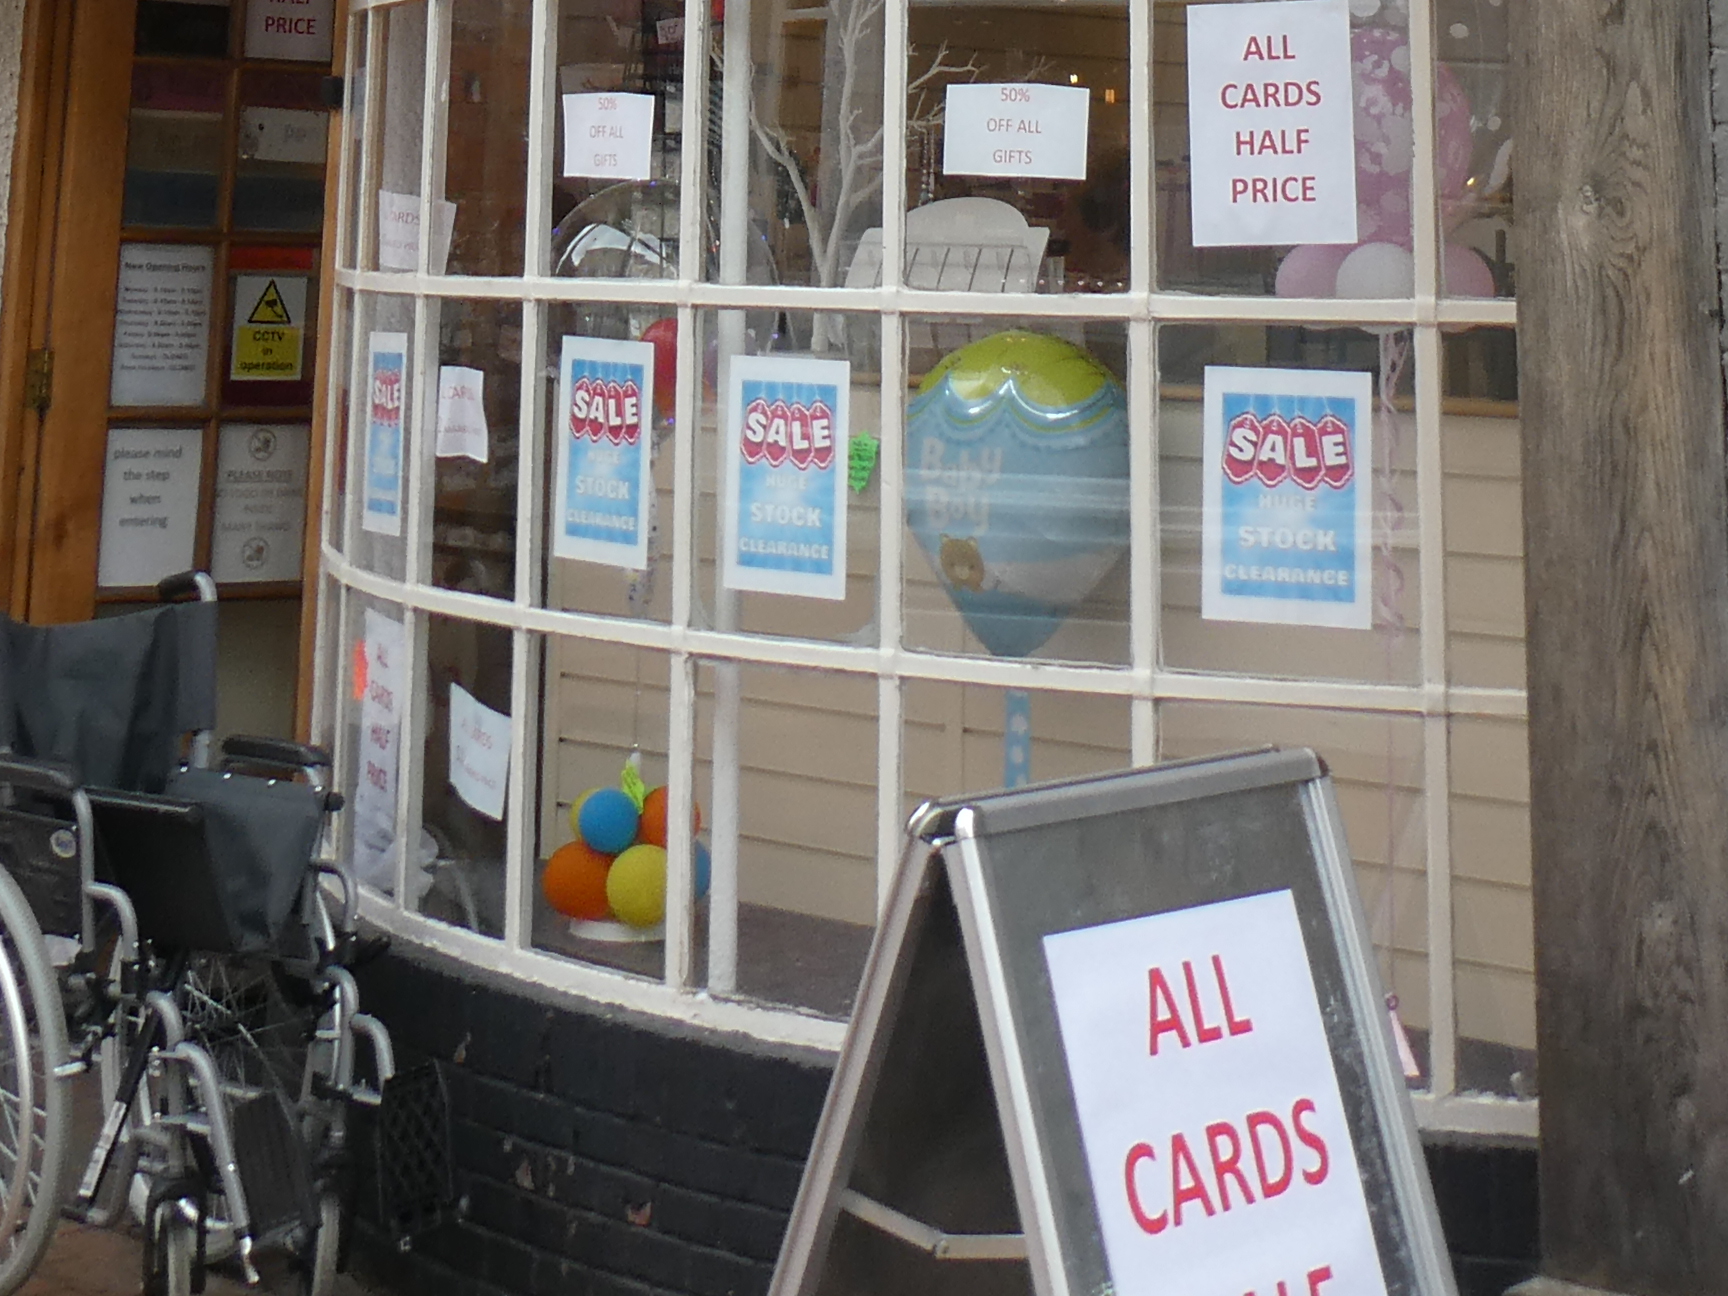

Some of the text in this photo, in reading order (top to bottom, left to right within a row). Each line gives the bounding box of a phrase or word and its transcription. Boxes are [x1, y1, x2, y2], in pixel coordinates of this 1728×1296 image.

[264, 15, 317, 35] PRICE
[1242, 33, 1296, 61] ALL
[598, 96, 618, 111] 50%
[1000, 87, 1030, 103] 50%
[1220, 80, 1322, 110] CARDS
[589, 124, 624, 139] OFF ALL
[986, 117, 1042, 134] OFF ALL
[1235, 128, 1310, 156] HALF
[593, 153, 618, 167] GIFTS
[992, 149, 1033, 165] GIFTS
[1231, 176, 1317, 204] PRICE
[252, 329, 285, 342] CCTV
[238, 360, 294, 373] operation
[573, 390, 639, 426] SALE
[745, 410, 832, 450] SALE
[113, 445, 183, 460] please mind
[1228, 427, 1347, 469] SALE
[123, 469, 170, 482] the step
[765, 473, 809, 490] HUGE
[575, 475, 631, 500] STOCK
[1258, 494, 1317, 512] HUGE
[118, 516, 169, 529] entering
[566, 508, 636, 531] CLEARANCE
[750, 502, 823, 528] STOCK
[739, 537, 831, 560] CLEARANCE
[1238, 525, 1337, 552] STOCK
[1224, 563, 1351, 587] CLEARANCE
[1148, 954, 1254, 1057] ALL
[1124, 1098, 1330, 1236] CARDS
